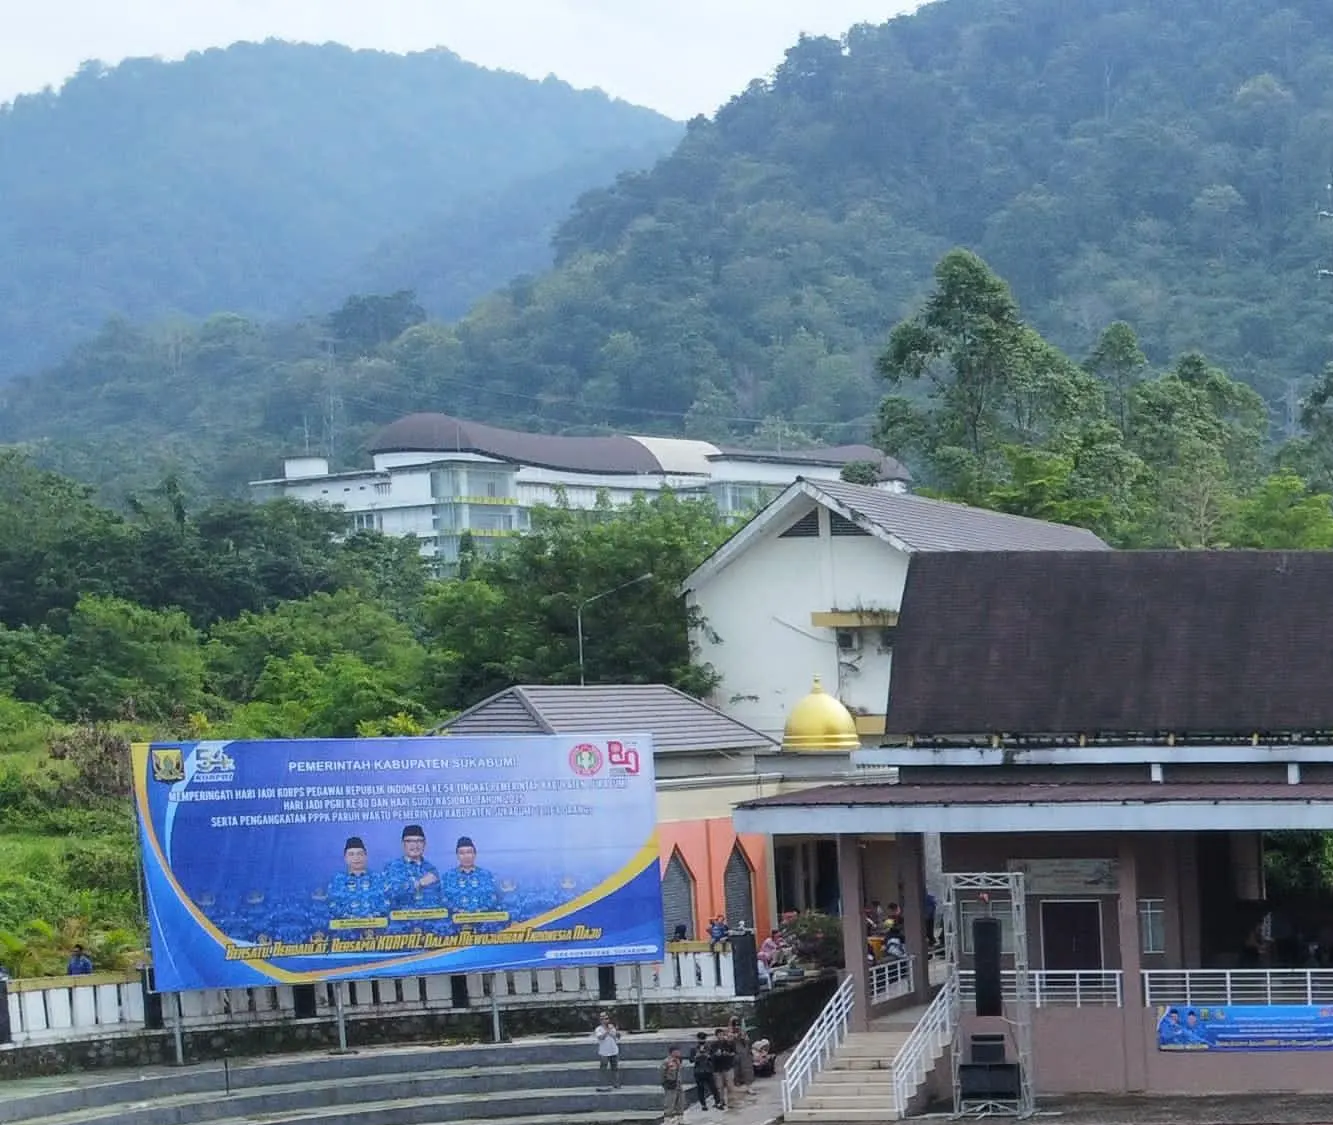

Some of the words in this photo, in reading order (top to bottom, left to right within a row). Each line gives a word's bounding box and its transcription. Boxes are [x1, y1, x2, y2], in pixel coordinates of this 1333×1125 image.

[288, 760, 371, 772] PEMERINTAH
[374, 759, 449, 770] KABUPATEN
[452, 757, 518, 769] SUKABUMI
[168, 789, 233, 801] MEMPERINGATI
[235, 788, 256, 799] HARI
[257, 787, 276, 799] JADI
[277, 786, 304, 798] KORPS
[306, 785, 343, 797] PEGAWAI
[346, 784, 385, 796] REPUBLIK
[387, 783, 430, 795] INDONESIA
[283, 799, 303, 811] HARI
[305, 799, 323, 810] JADI
[371, 798, 389, 807] DAN
[391, 797, 410, 807] HARI
[211, 815, 238, 828] SERTA
[240, 813, 306, 827] PENGANGKATAN
[307, 813, 330, 824] PPPK
[332, 812, 360, 823] PARUH
[362, 811, 391, 822] WAKTU
[393, 809, 443, 821] PEMERINTAH
